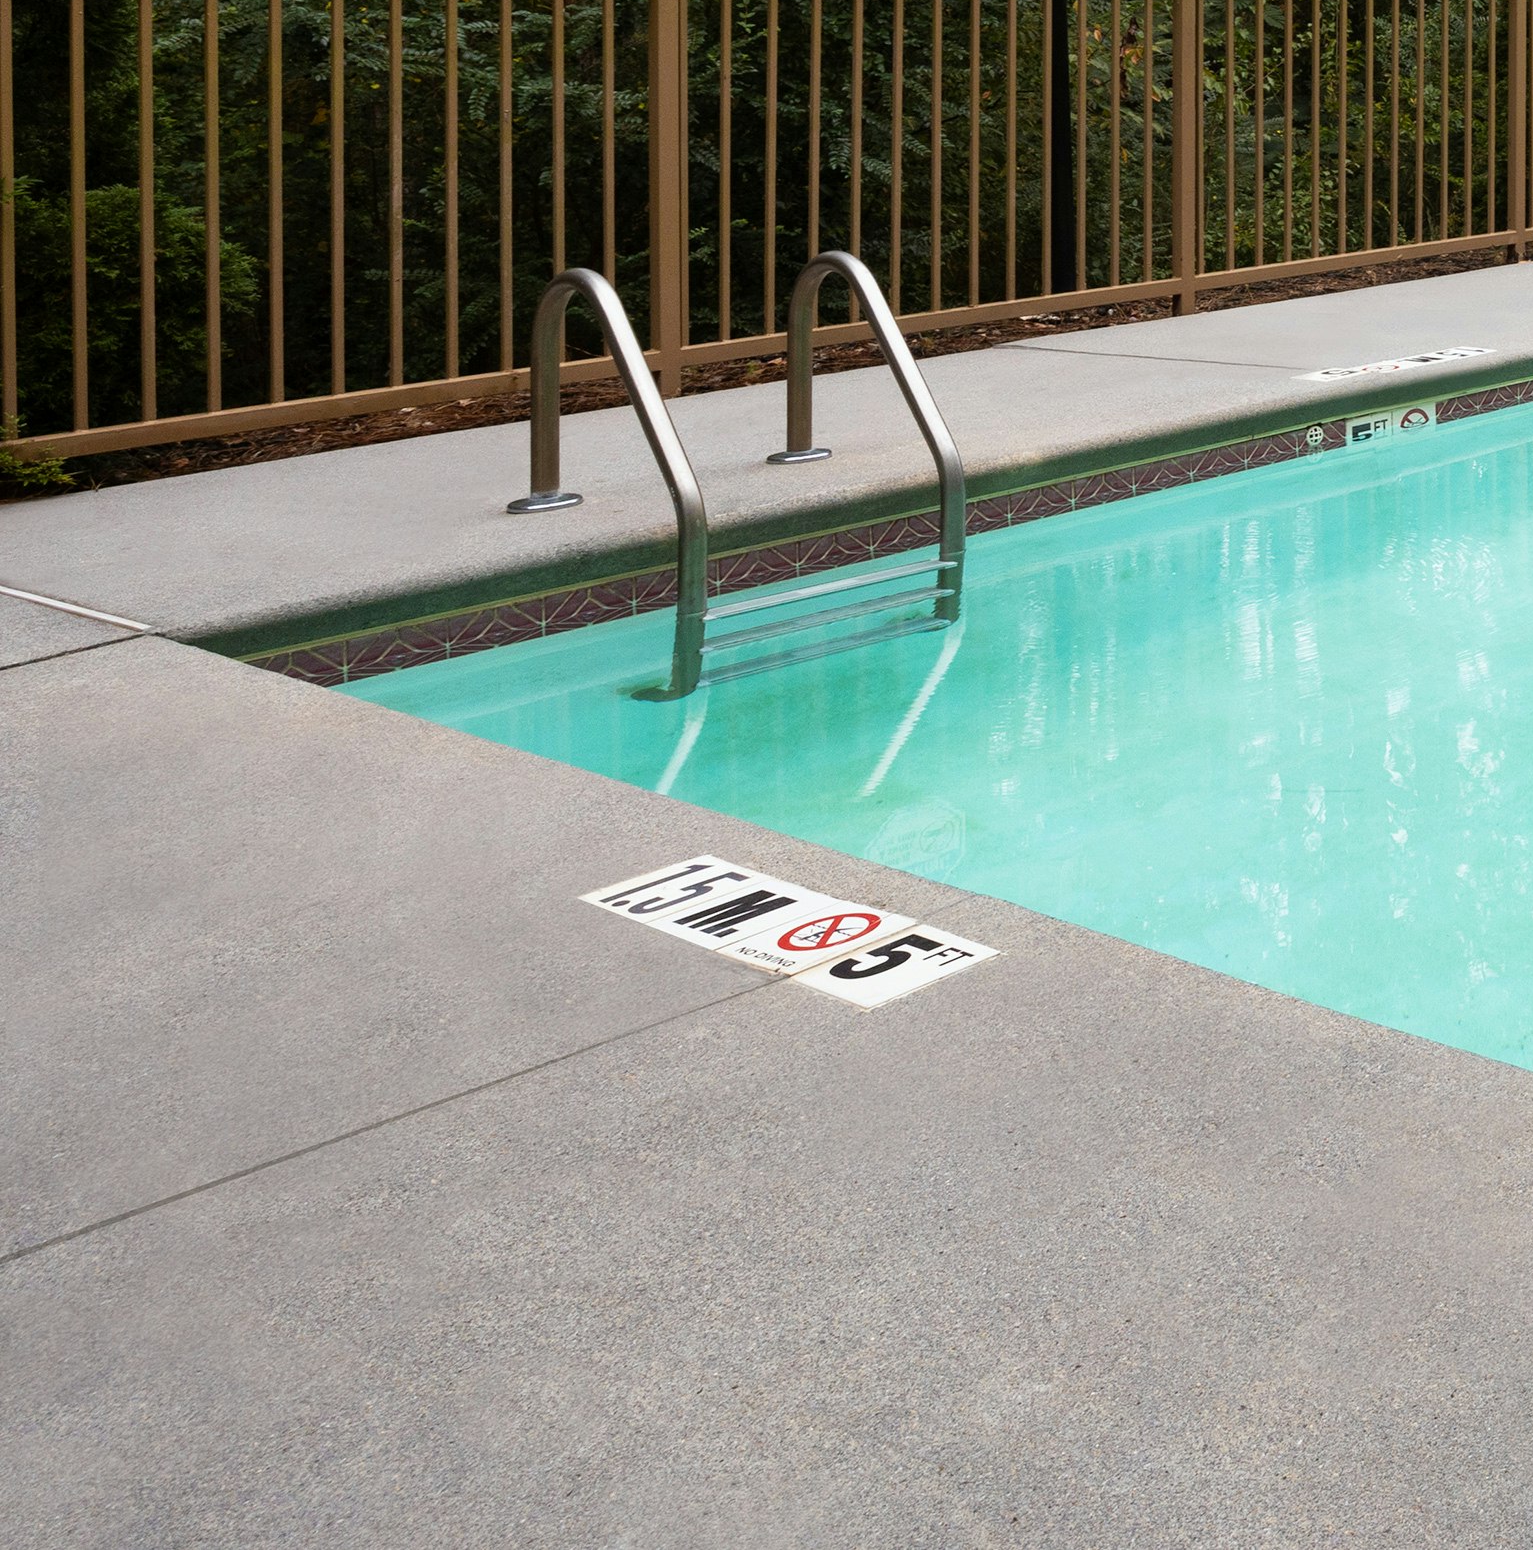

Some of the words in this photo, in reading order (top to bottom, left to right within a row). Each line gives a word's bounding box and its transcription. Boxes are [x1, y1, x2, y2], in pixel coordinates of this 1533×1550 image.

[1352, 422, 1373, 442] 5
[1374, 419, 1388, 432] FT
[599, 864, 751, 915] 1.5
[673, 890, 798, 939] M.
[735, 946, 758, 956] NO
[754, 952, 796, 967] DIVING
[829, 934, 945, 980] 5
[923, 947, 975, 967] FT
